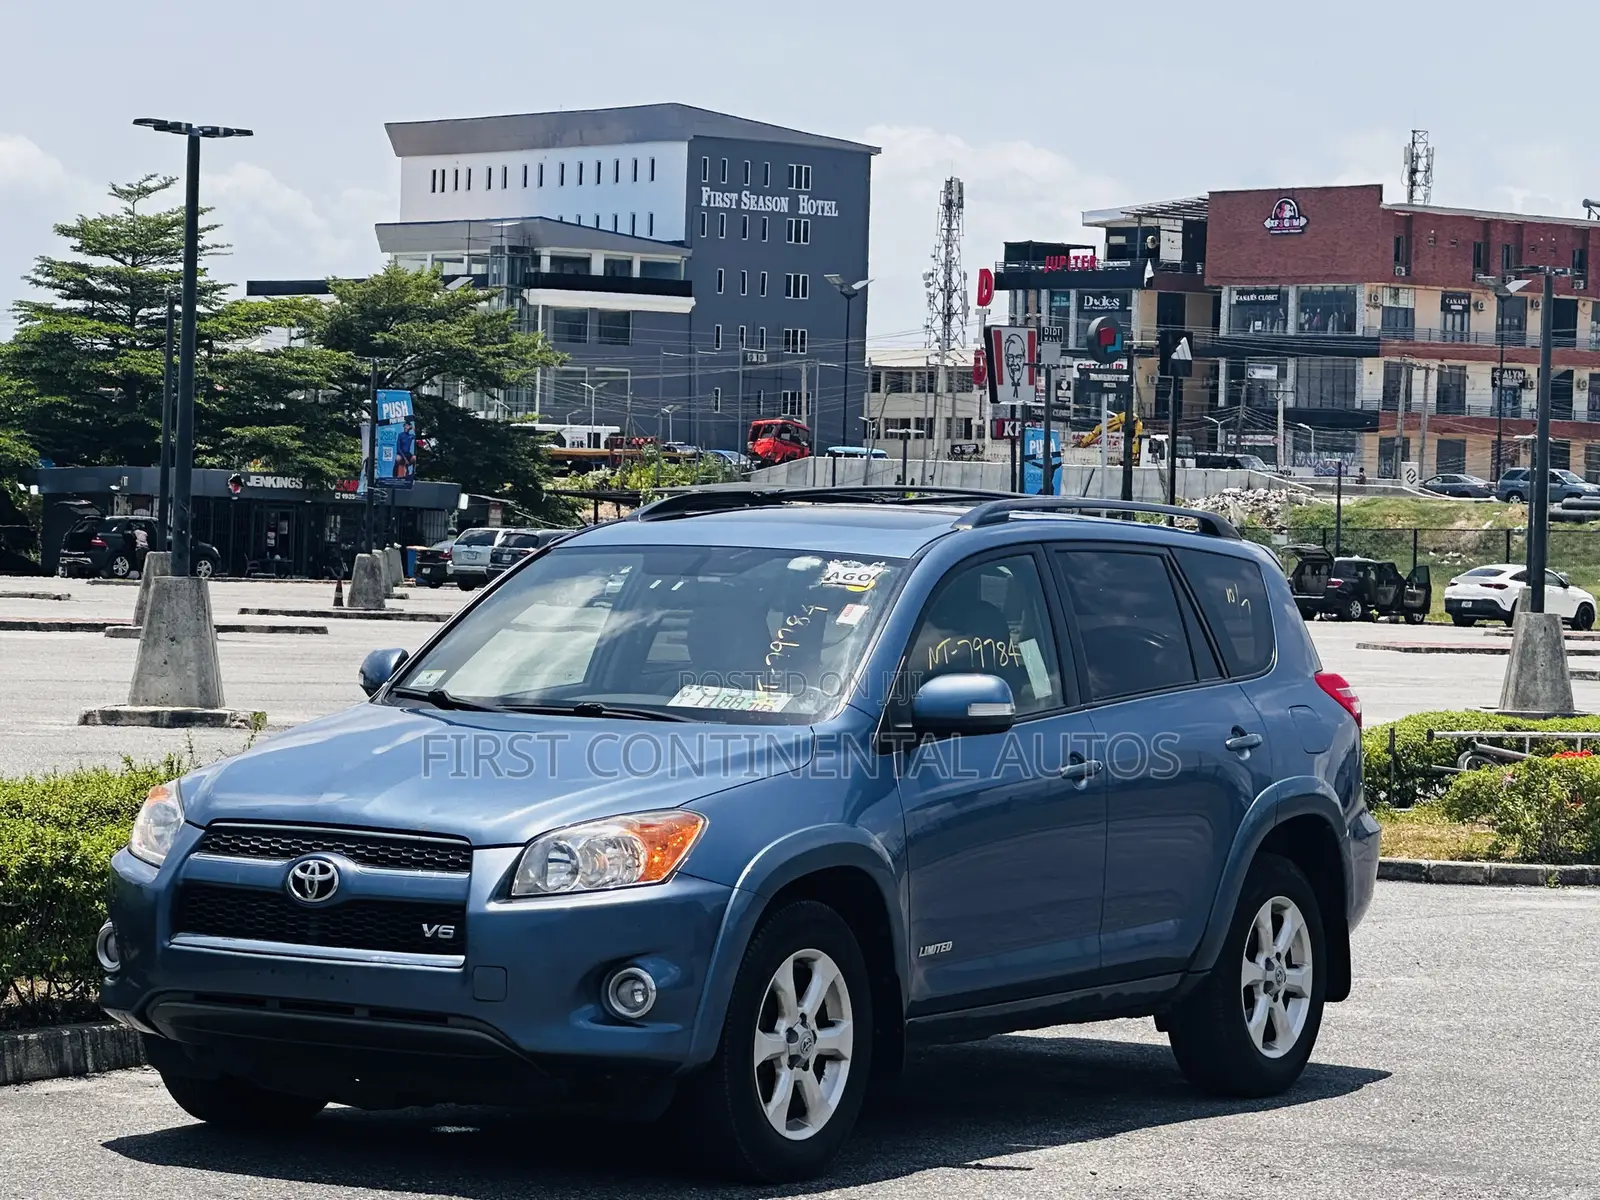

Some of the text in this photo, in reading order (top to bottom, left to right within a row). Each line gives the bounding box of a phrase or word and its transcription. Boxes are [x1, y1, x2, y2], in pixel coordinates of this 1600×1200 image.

[701, 187, 838, 217] FIRST SEASON HOTEL
[1043, 255, 1097, 273] JUPITER
[1044, 327, 1060, 336] DIDI
[382, 401, 409, 419] PUSH
[246, 475, 303, 489] JENKINGS
[422, 923, 455, 939] V6
[918, 940, 953, 958] LIMITED
